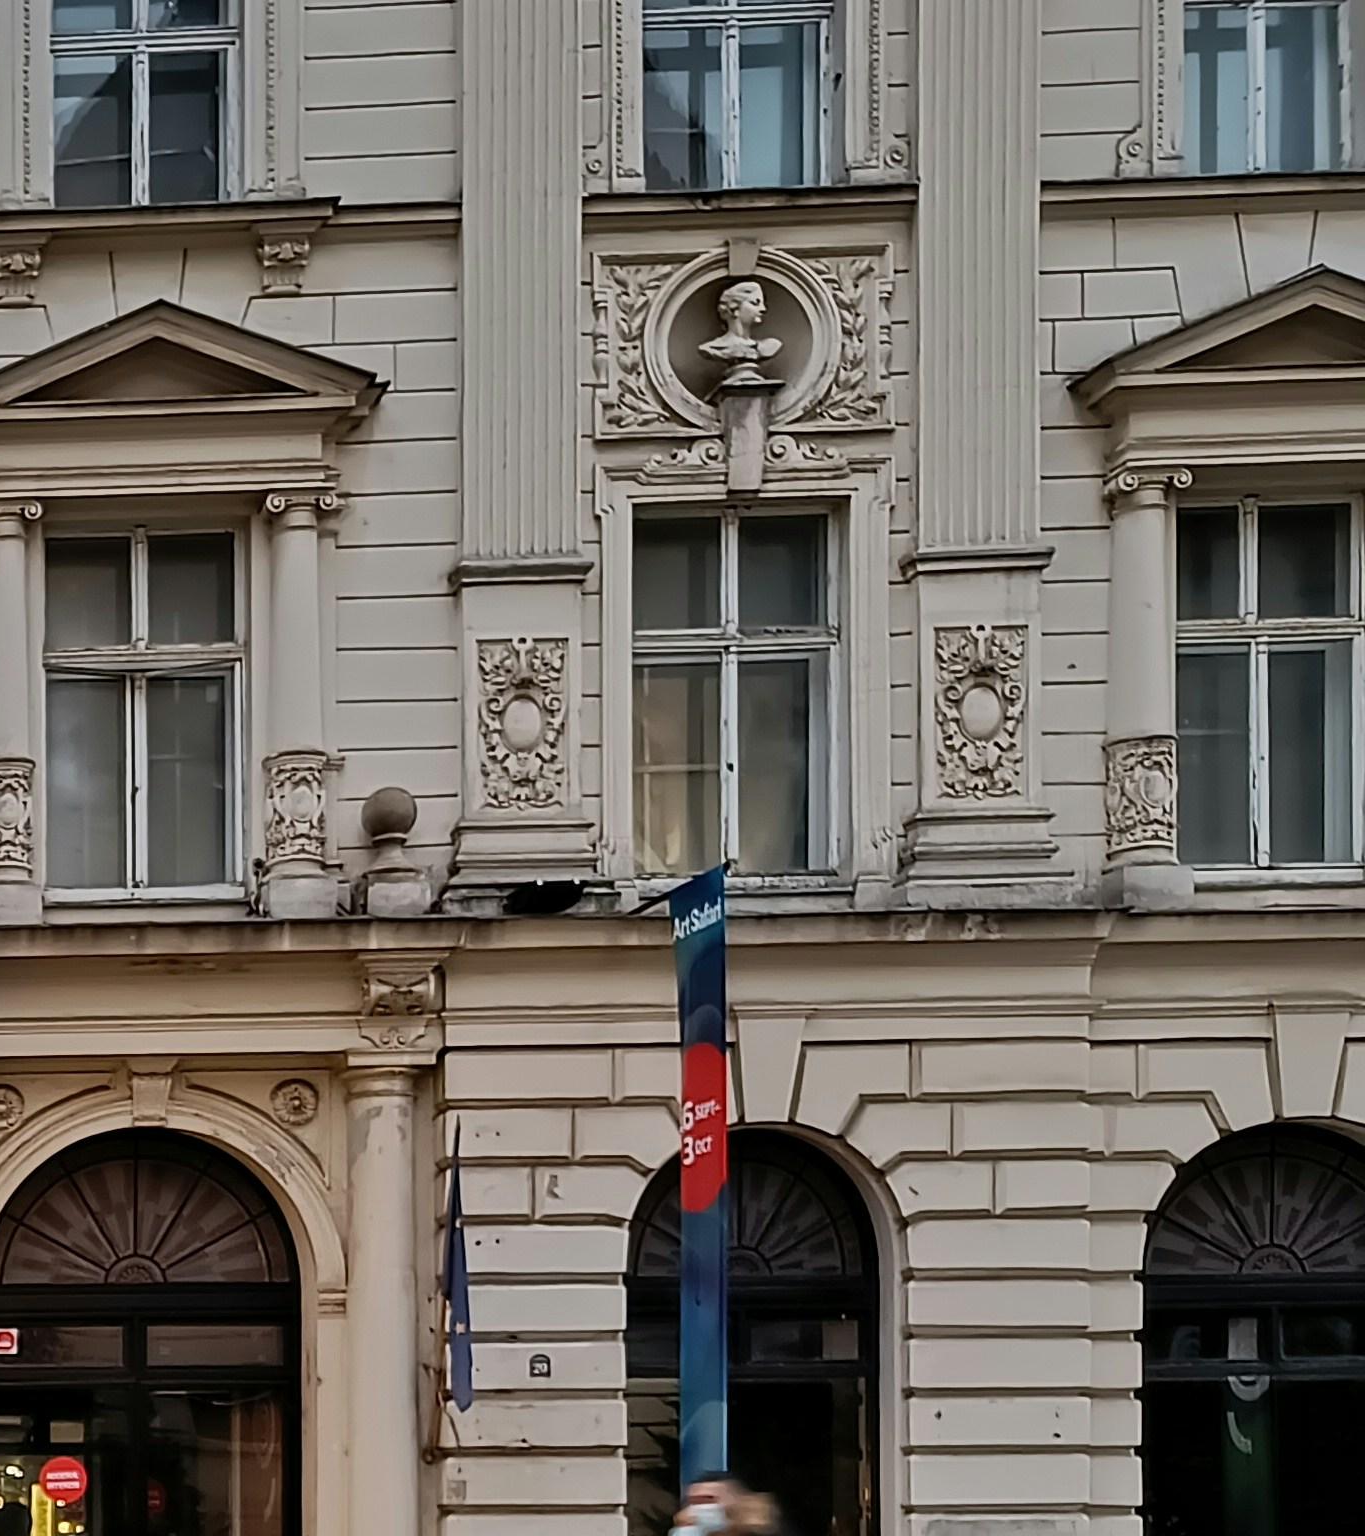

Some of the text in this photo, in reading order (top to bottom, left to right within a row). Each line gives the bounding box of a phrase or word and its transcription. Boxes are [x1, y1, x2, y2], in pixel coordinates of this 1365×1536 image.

[673, 915, 690, 940] Art
[679, 1101, 694, 1132] 6
[682, 1136, 695, 1166] 3
